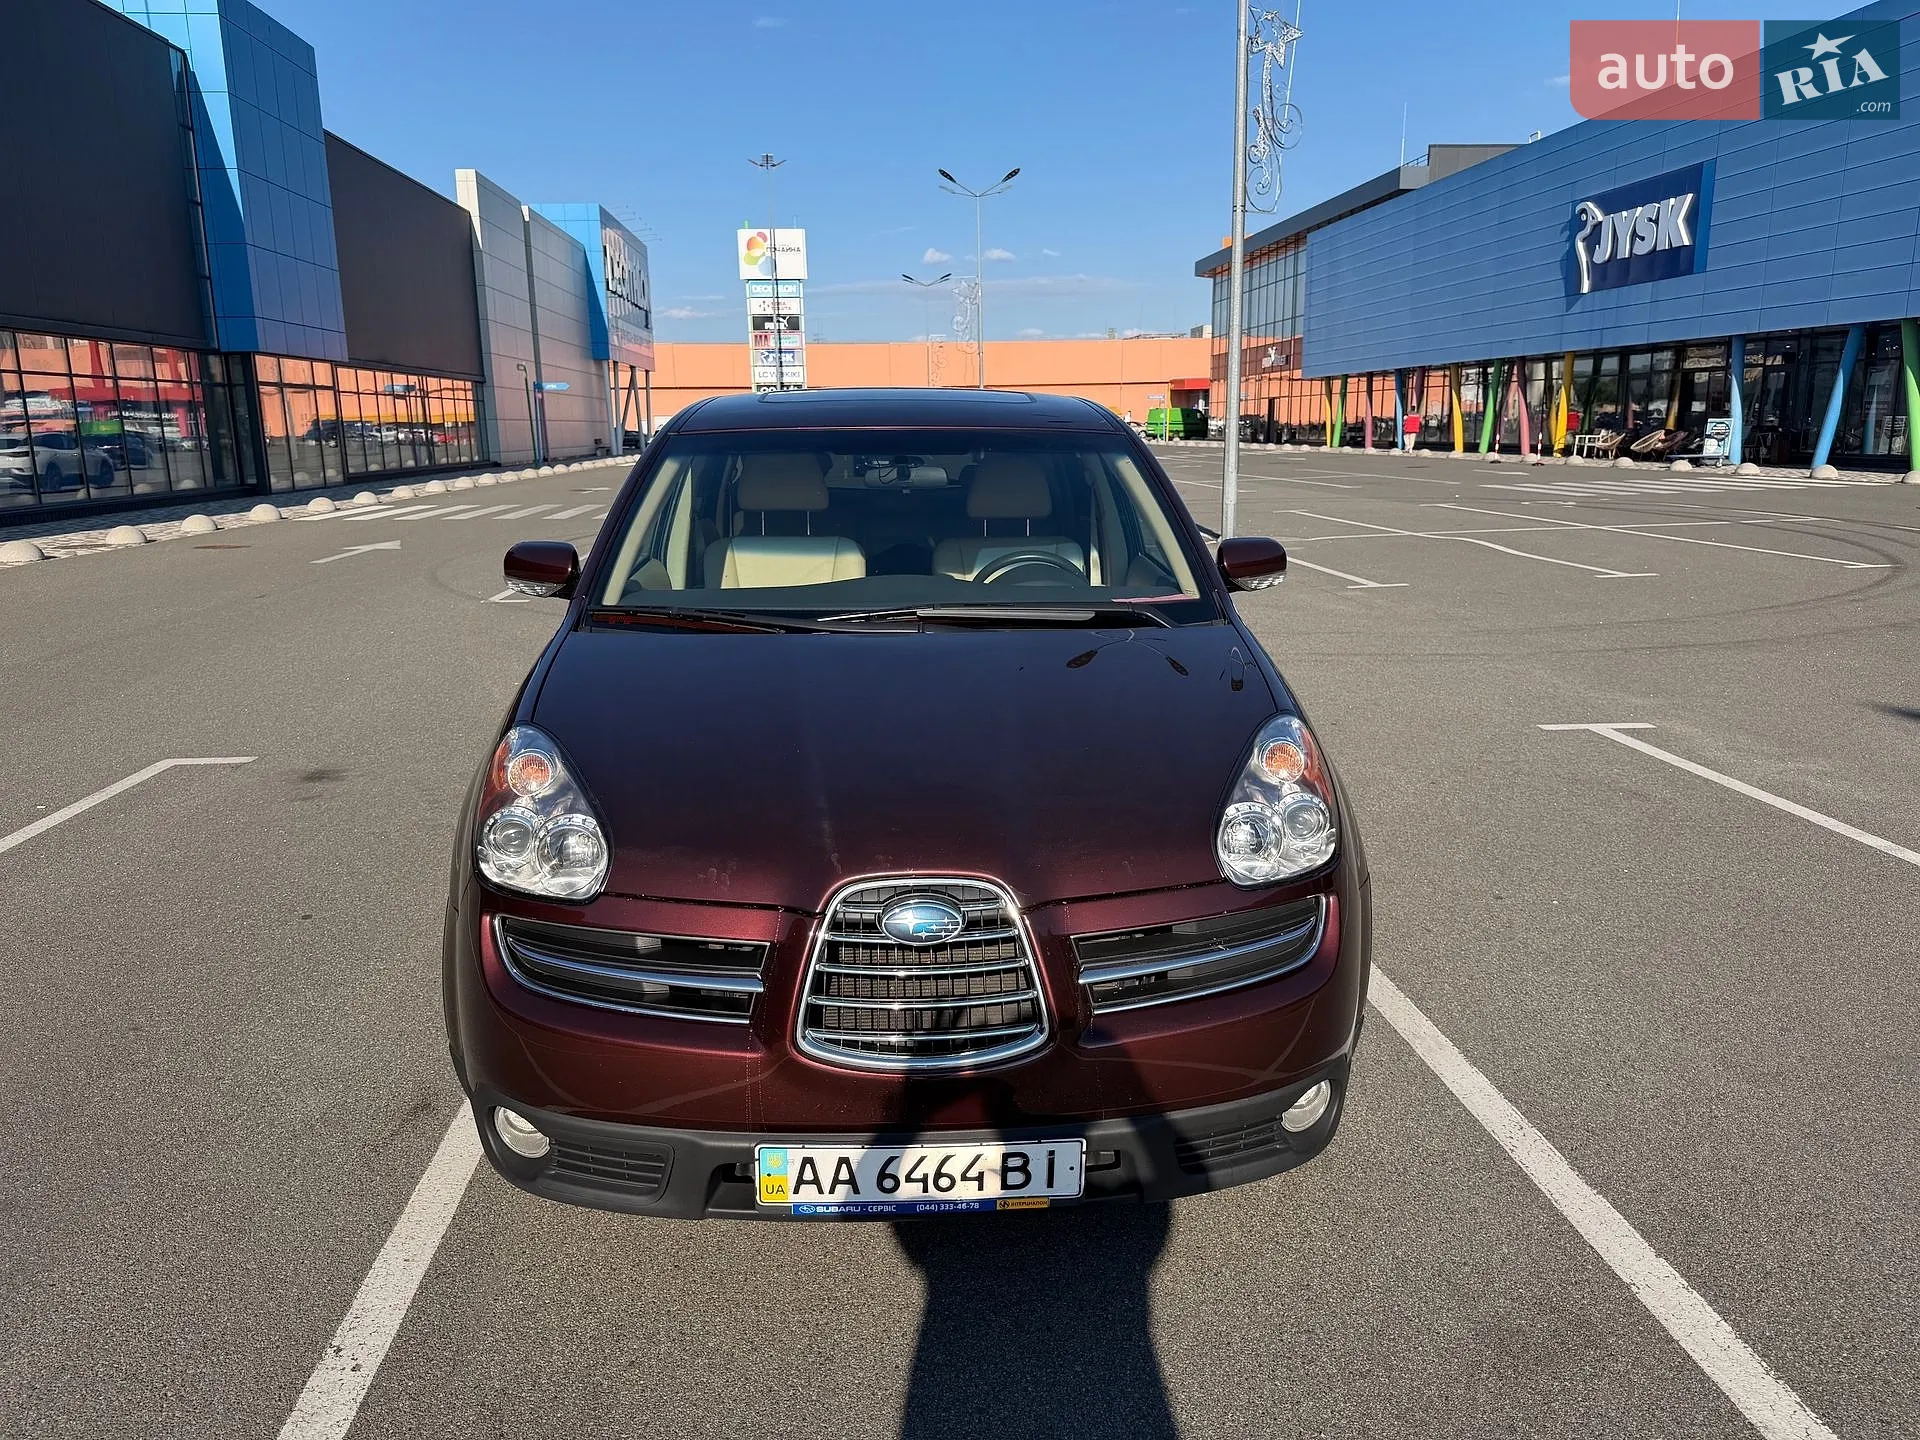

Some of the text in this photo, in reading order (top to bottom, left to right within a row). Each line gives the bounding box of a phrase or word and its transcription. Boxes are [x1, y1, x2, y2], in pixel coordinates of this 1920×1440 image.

[1593, 193, 1694, 264] JYSK
[766, 1150, 1055, 1195] UA AA 6464 BI
[816, 1204, 861, 1212] SUBARU
[916, 1203, 938, 1212] (044)
[939, 1202, 980, 1211] 333-46-78
